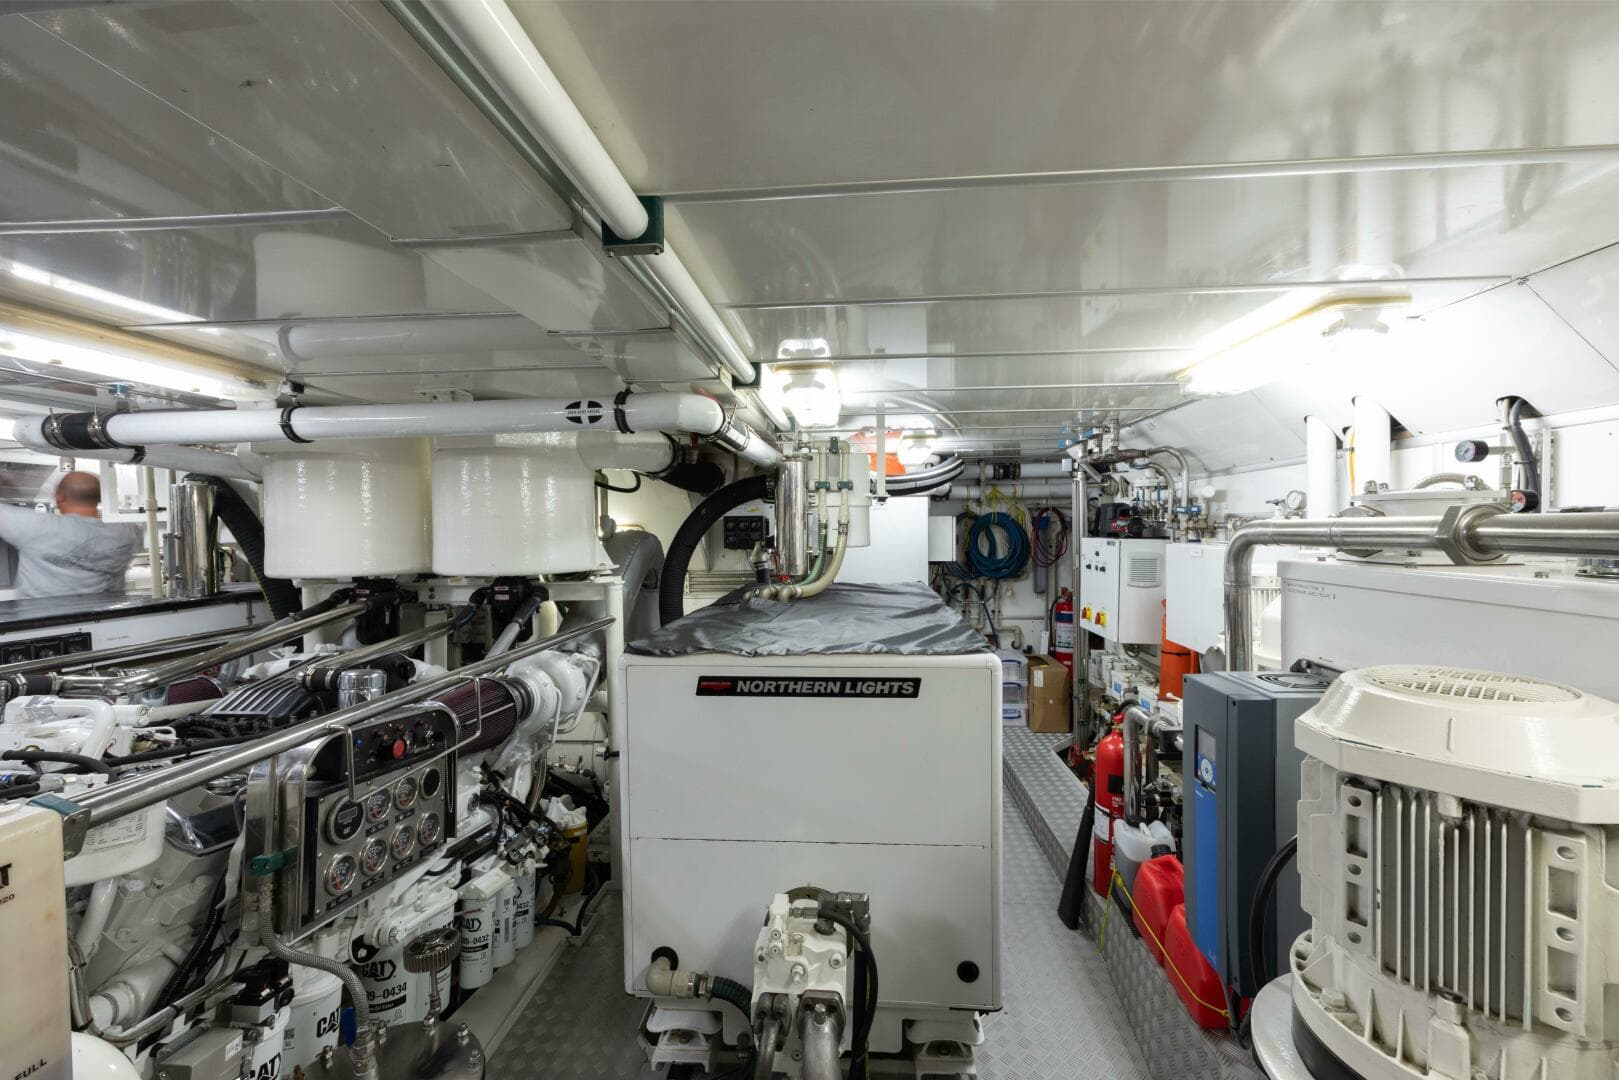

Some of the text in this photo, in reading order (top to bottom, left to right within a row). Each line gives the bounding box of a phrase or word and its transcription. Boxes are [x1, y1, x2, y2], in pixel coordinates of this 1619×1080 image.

[736, 680, 914, 694] NORTHERN LIGHTS
[0, 863, 12, 888] T
[362, 961, 388, 978] CAT
[14, 1059, 48, 1080] FULL
